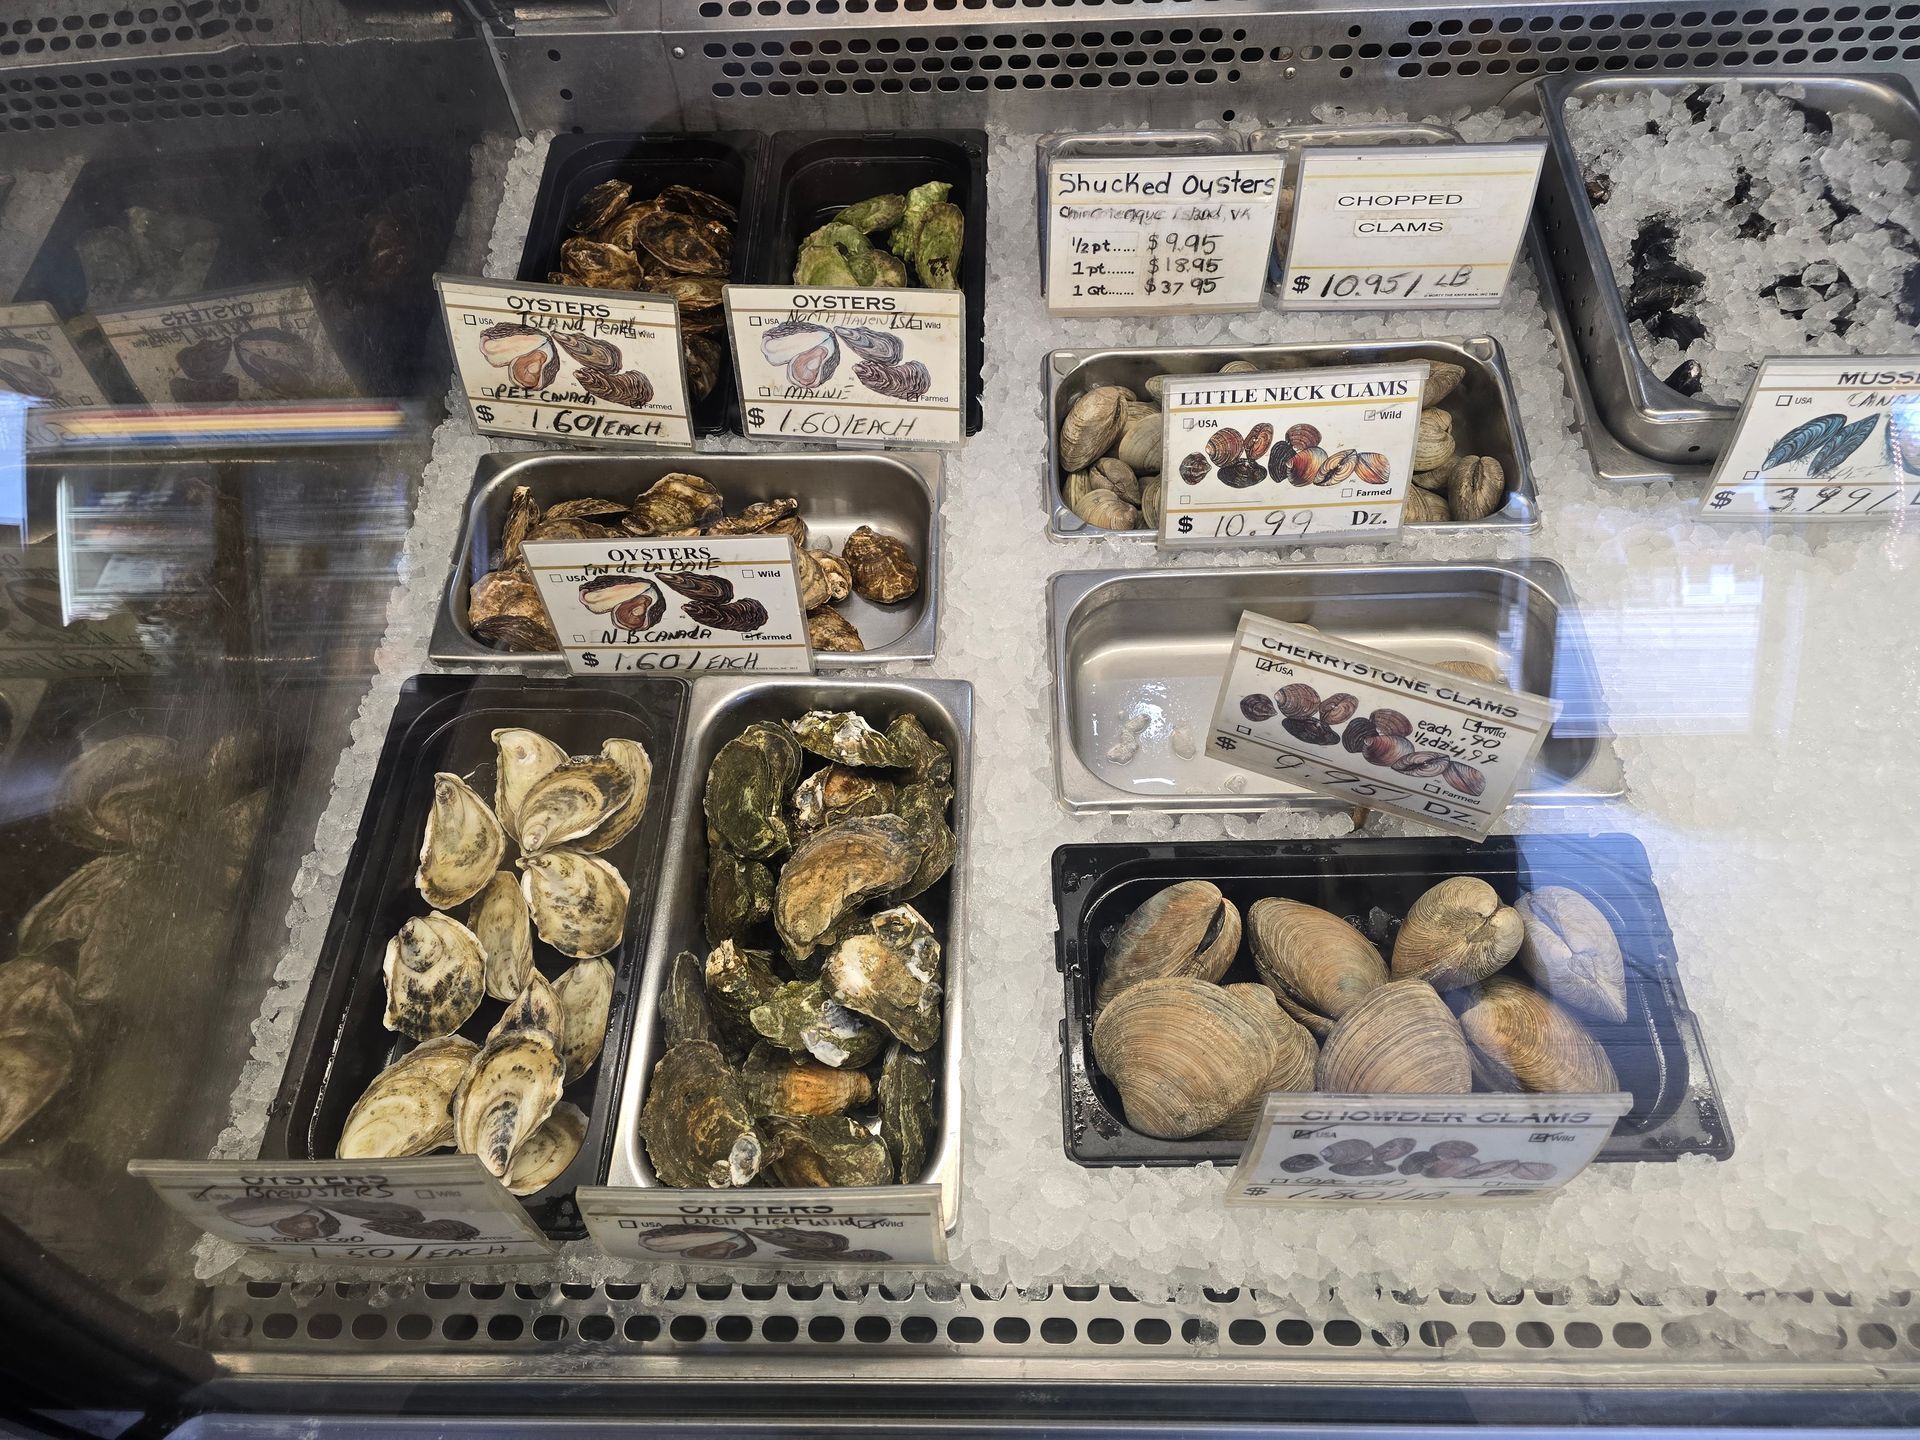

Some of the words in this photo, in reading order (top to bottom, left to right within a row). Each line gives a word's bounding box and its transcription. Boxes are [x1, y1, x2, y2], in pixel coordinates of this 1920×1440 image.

[1058, 171, 1172, 197] Shucked
[1182, 170, 1276, 198] Oysters
[1337, 194, 1464, 207] CHOPPED
[1358, 222, 1444, 233] CLAMS
[1292, 275, 1311, 294] $
[506, 295, 611, 318] OYSTERS
[792, 295, 896, 311] OYSTERS
[478, 317, 495, 325] USA
[764, 318, 780, 326] USA
[638, 331, 656, 339] Wild
[920, 394, 948, 403] Farmed
[1180, 388, 1258, 406] LITTLE
[1264, 384, 1330, 403] NECK
[1337, 380, 1409, 398] CLAMS
[644, 403, 672, 411] Farmed
[1795, 397, 1812, 405] USA
[475, 404, 495, 424] $
[747, 407, 766, 429] $
[1379, 410, 1402, 420] Wild
[1198, 420, 1218, 429] USA
[1356, 488, 1392, 497] Farmed
[1709, 490, 1736, 510] $
[1177, 515, 1194, 534] $
[1213, 510, 1314, 538] 10.99
[607, 546, 711, 562] OYSTERS
[758, 570, 781, 578] Wild
[755, 633, 793, 641] Farmed
[581, 651, 599, 667] $
[1275, 665, 1294, 677] USA
[1261, 636, 1432, 695] CHERRYSTONE
[1435, 686, 1520, 720] CLAMS
[1417, 719, 1452, 738] each
[1216, 736, 1238, 751] $
[1442, 790, 1480, 806] Farmed
[1300, 1111, 1466, 1124] CHOWDER
[1475, 1112, 1593, 1124] CLAMS
[1243, 1186, 1270, 1197] $
[641, 1221, 663, 1229] USA
[879, 1219, 904, 1229] Wild
